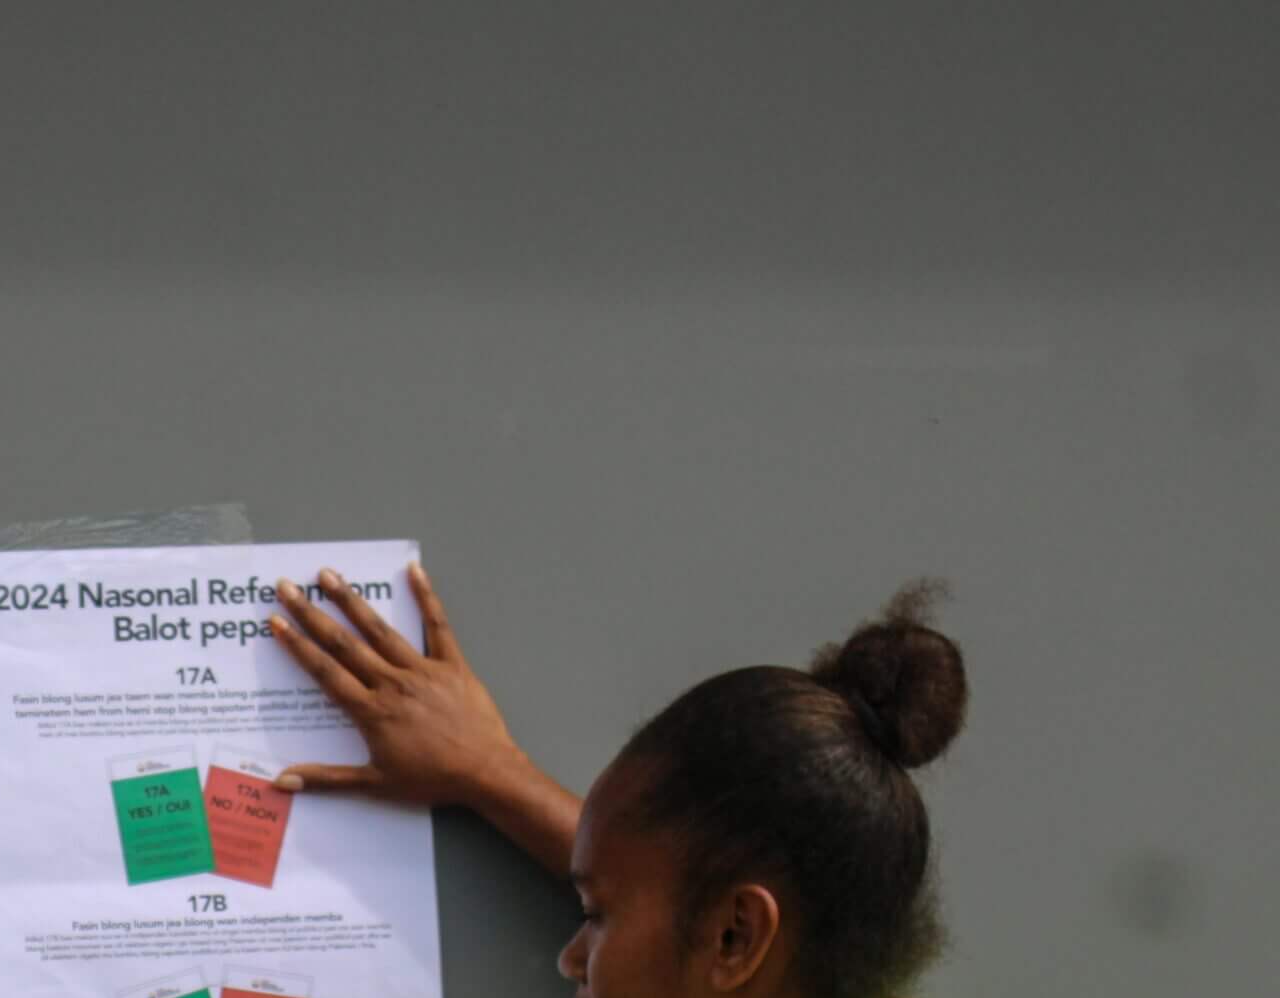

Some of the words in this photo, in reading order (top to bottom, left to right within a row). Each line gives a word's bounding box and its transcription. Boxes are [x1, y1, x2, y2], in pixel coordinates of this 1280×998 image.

[78, 578, 198, 608] Nasonal
[114, 613, 191, 642] Balot
[176, 668, 216, 685] 17A
[144, 784, 170, 798] 17A
[237, 784, 261, 800] 17A
[128, 805, 152, 819] YES
[166, 800, 191, 812] OUI
[211, 796, 232, 810] NO
[245, 805, 278, 822] NON
[188, 895, 228, 912] 17B
[101, 920, 130, 931] blong
[184, 917, 214, 928] blong
